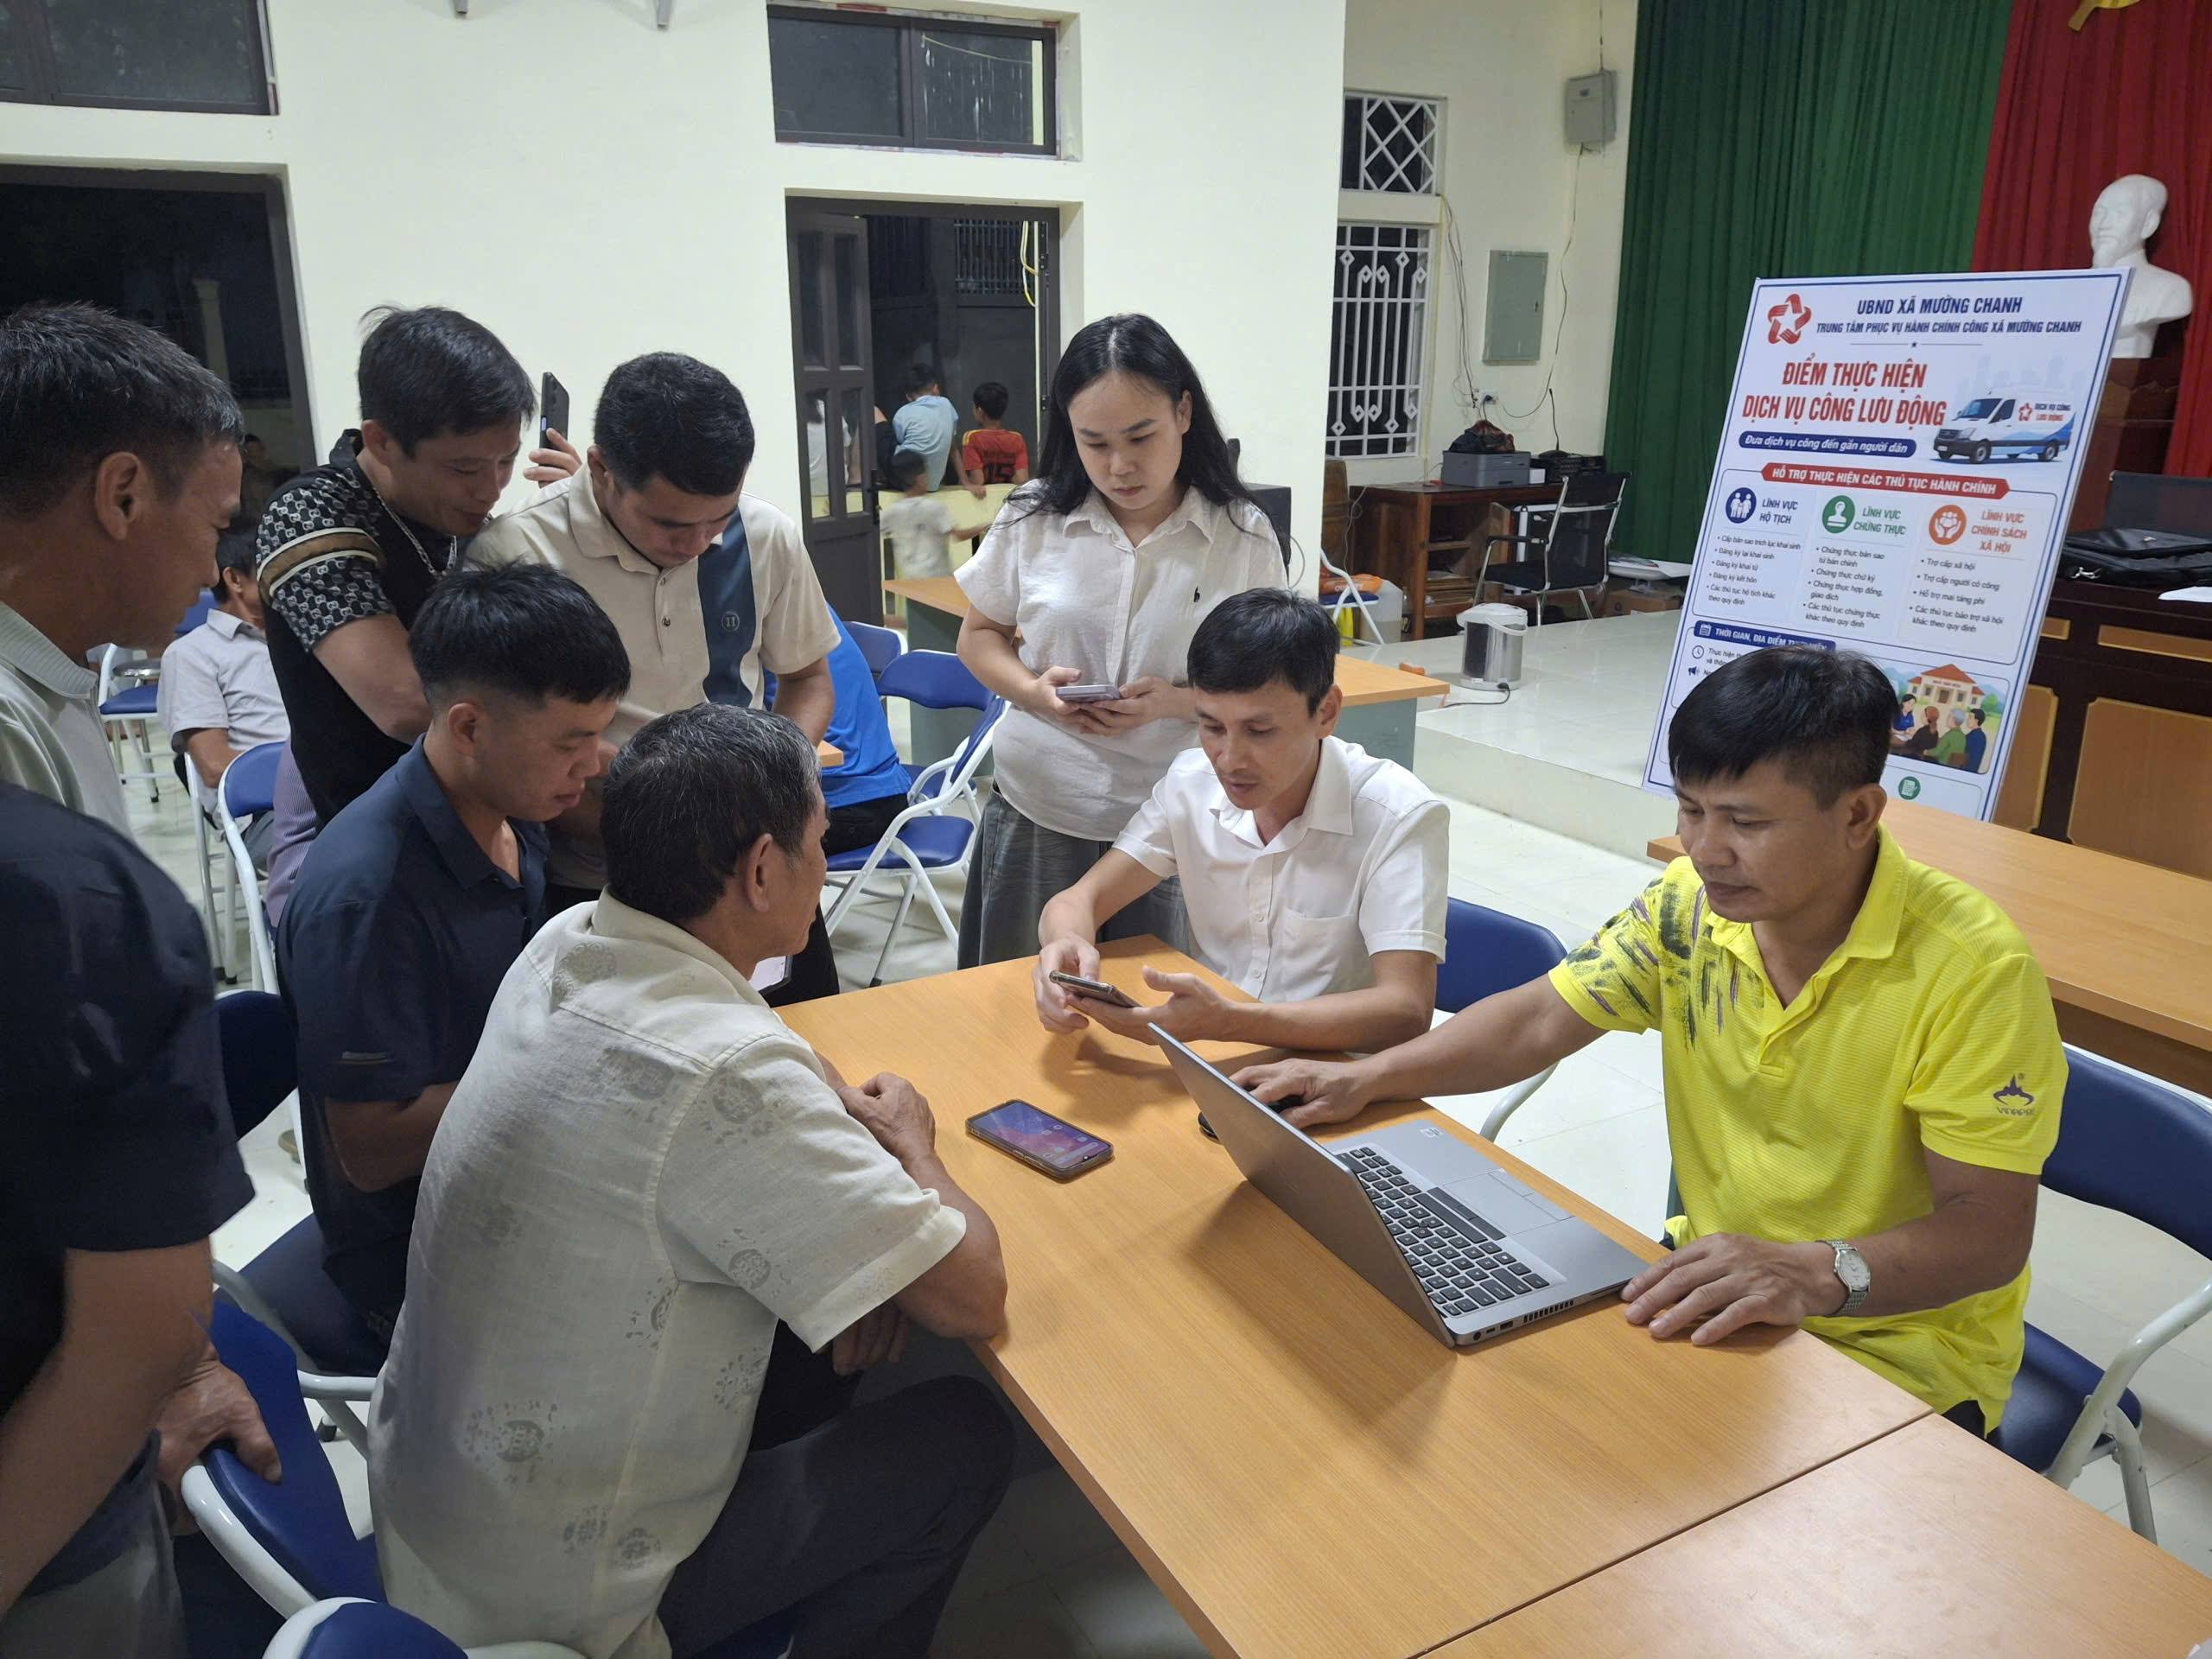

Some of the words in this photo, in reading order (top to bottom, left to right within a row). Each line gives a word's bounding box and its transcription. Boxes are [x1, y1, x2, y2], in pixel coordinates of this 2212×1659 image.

[1858, 299, 1893, 315] UBND
[1897, 296, 1916, 314] XÃ
[1920, 296, 1969, 314] MƯỜNG
[1974, 297, 2023, 314] CHANH
[1816, 323, 1843, 334] TRUNG
[1847, 321, 1864, 333] TÂM
[1866, 322, 1890, 334] PHỤC
[1891, 322, 1902, 335] VỤ
[1905, 321, 1929, 333] HÀNH
[1932, 321, 1961, 333] CHÍNH
[1963, 321, 1988, 333] CÔNG
[1991, 320, 2005, 333] XÃ
[2007, 320, 2043, 333] MƯỜNG
[2046, 321, 2082, 333] CHANH
[1783, 353, 1827, 385] ĐIỂM
[1832, 361, 1878, 392] THỰC
[1881, 359, 1928, 393] HIỆN
[1742, 395, 1781, 423] DỊCH
[1784, 397, 1806, 424] VỤ
[1808, 392, 1855, 422] CÔNG
[1858, 397, 1893, 423] LƯU
[1895, 395, 1947, 430] ĐỘNG
[1745, 435, 1762, 445] Đưa
[1764, 435, 1783, 448] dịch
[1785, 439, 1796, 448] vụ
[1798, 437, 1819, 450] công
[1821, 437, 1839, 449] đến
[1840, 439, 1858, 451] gần
[1859, 441, 1887, 452] người
[1889, 441, 1908, 453] dân
[1772, 467, 1786, 479] HỖ
[1789, 469, 1807, 481] TRỢ
[1809, 470, 1834, 483] THỰC
[1837, 472, 1859, 485] HIỆN
[1862, 473, 1882, 486] CÁC
[1885, 475, 1905, 487] THỦ
[1908, 478, 1928, 490] TỤC
[1930, 478, 1960, 492] HÀNH
[1962, 480, 1996, 494] CHÍNH
[1715, 627, 1731, 638] THỜI
[1732, 631, 1751, 642] GIAN,
[1753, 634, 1766, 645] ĐỊA
